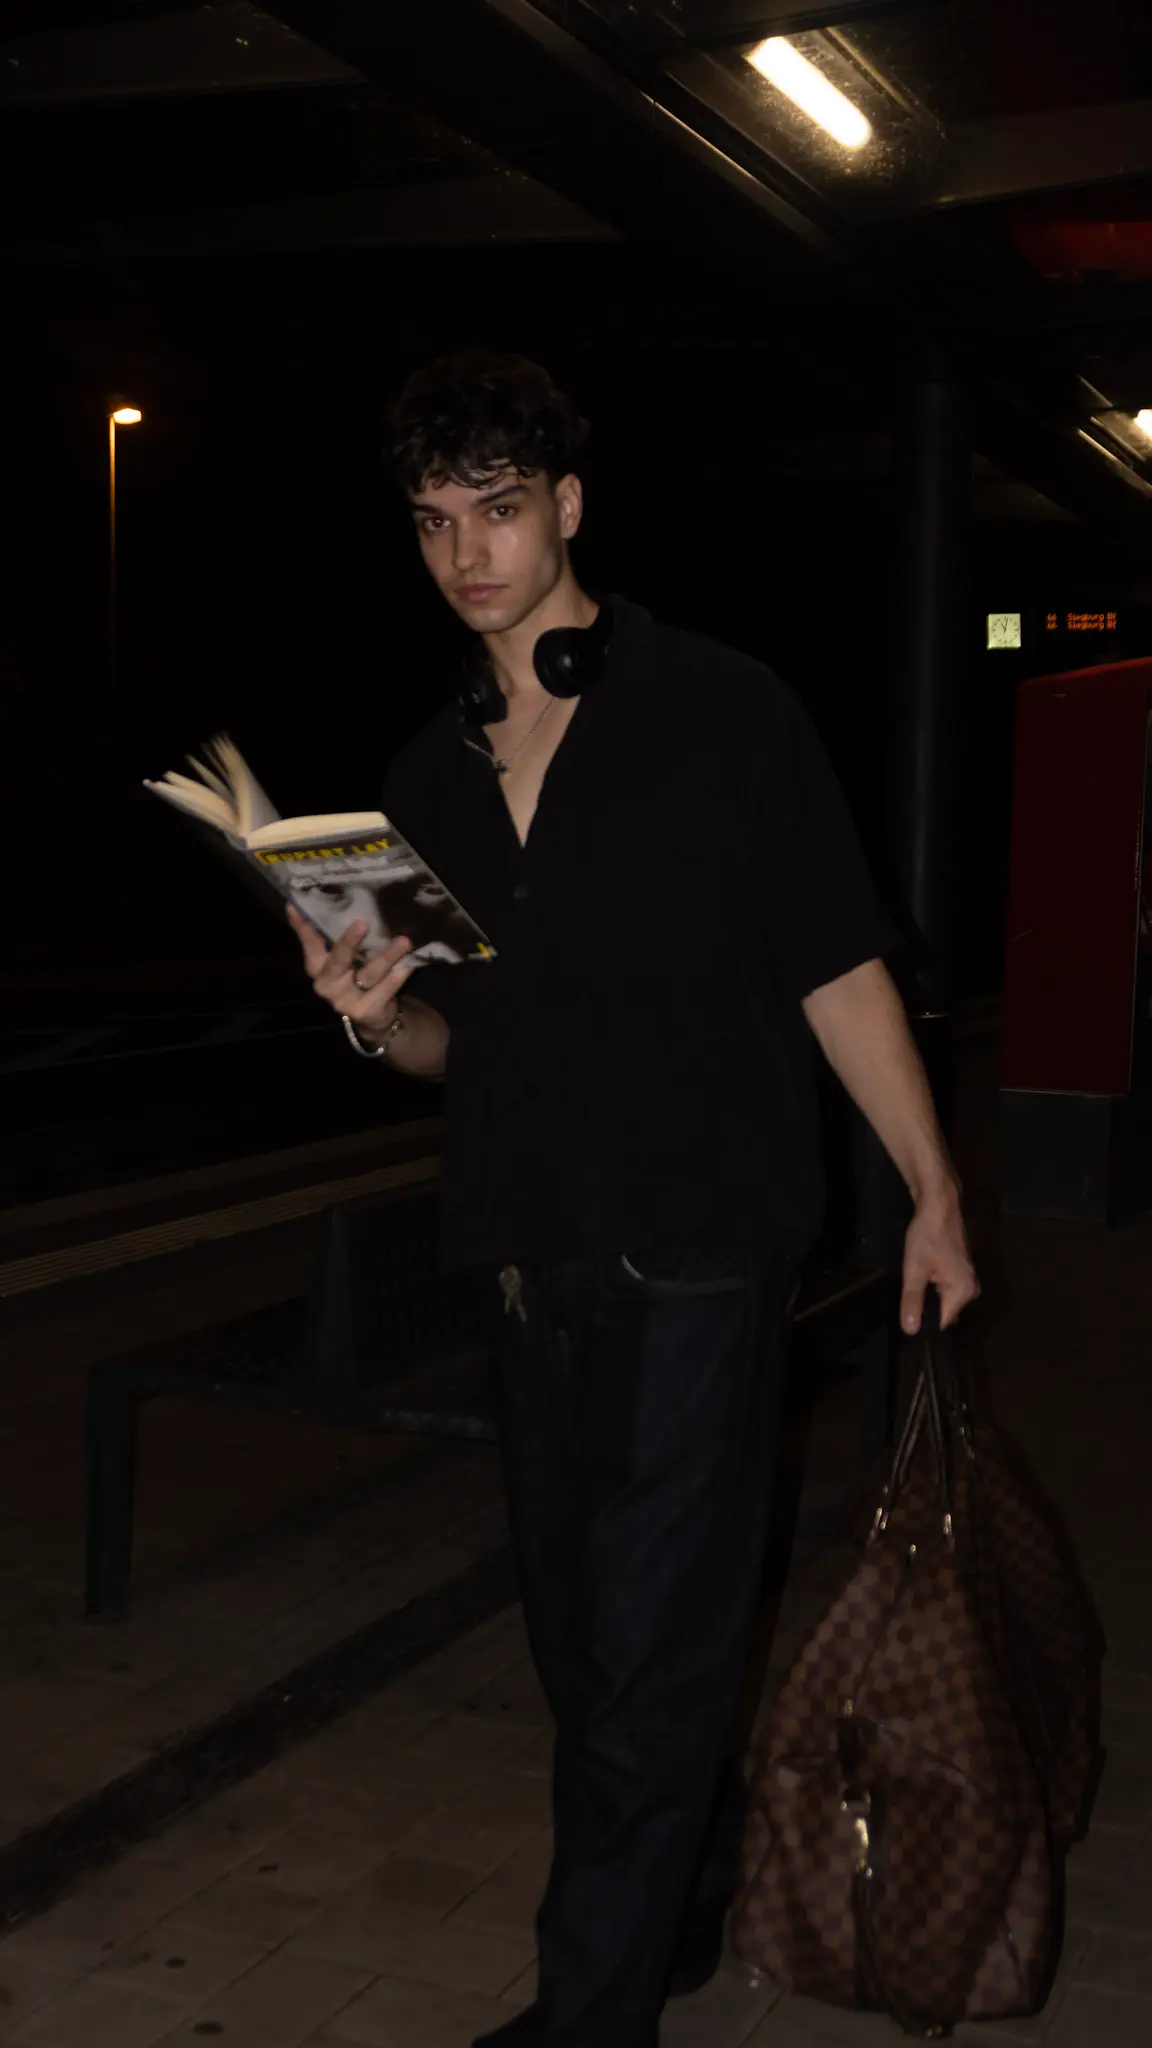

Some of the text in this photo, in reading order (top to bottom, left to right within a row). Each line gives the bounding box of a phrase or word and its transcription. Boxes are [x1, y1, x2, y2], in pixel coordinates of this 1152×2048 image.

[1067, 612, 1104, 622] Siegburg
[1067, 621, 1104, 631] Siegburg
[265, 838, 389, 864] RUPERT LAY
